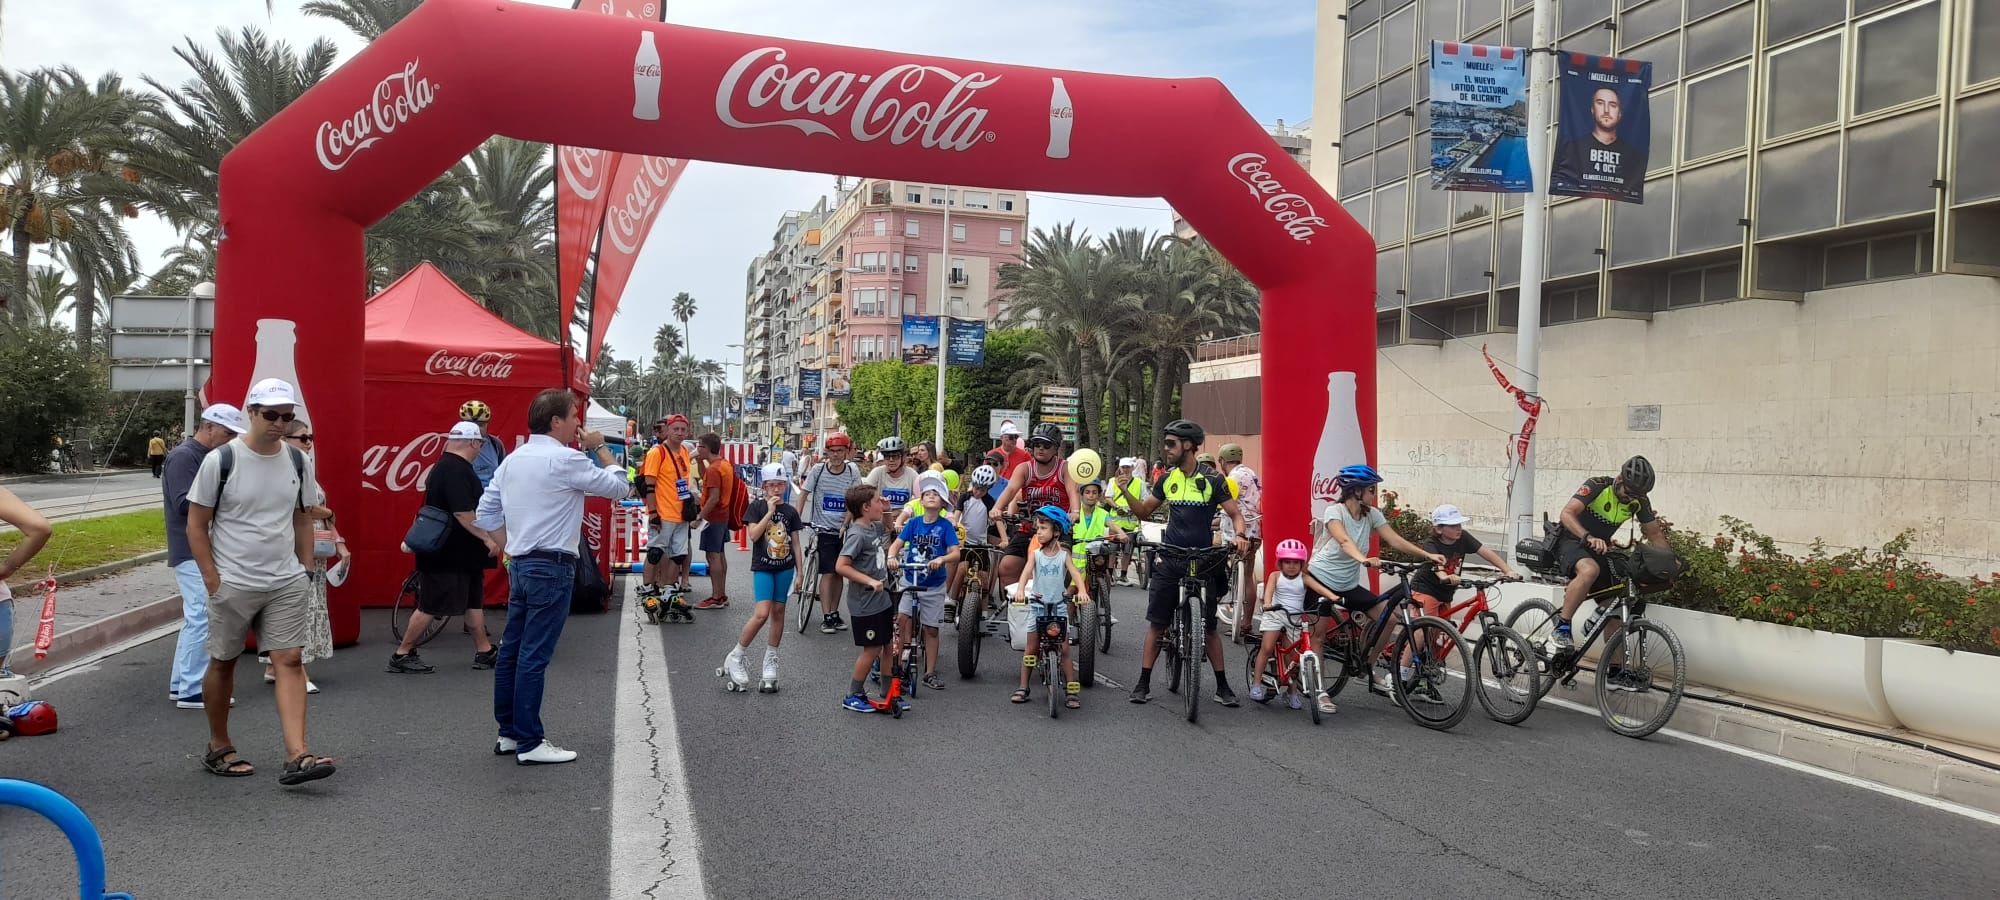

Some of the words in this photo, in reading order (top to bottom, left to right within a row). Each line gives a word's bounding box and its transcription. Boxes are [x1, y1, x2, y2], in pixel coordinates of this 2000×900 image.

[1466, 61, 1490, 71] MUELLE
[1464, 75, 1472, 83] EL
[1474, 76, 1496, 85] NUEVO
[1590, 71, 1615, 83] MUELLE
[1451, 83, 1475, 92] LATIDO
[1477, 85, 1509, 95] CULTURAL
[715, 46, 1002, 151] Coca-Cola
[1460, 92, 1468, 101] DE
[1471, 94, 1502, 104] ALICANTE
[315, 55, 434, 171] Coca-Cola
[1590, 148, 1621, 165] BERET
[1594, 162, 1600, 171] 4
[1602, 163, 1616, 174] OCT
[1227, 152, 1331, 241] Coca-Cola
[424, 349, 518, 379] Coca-Cola
[1079, 466, 1091, 475] 30
[911, 533, 943, 547] SONIC
